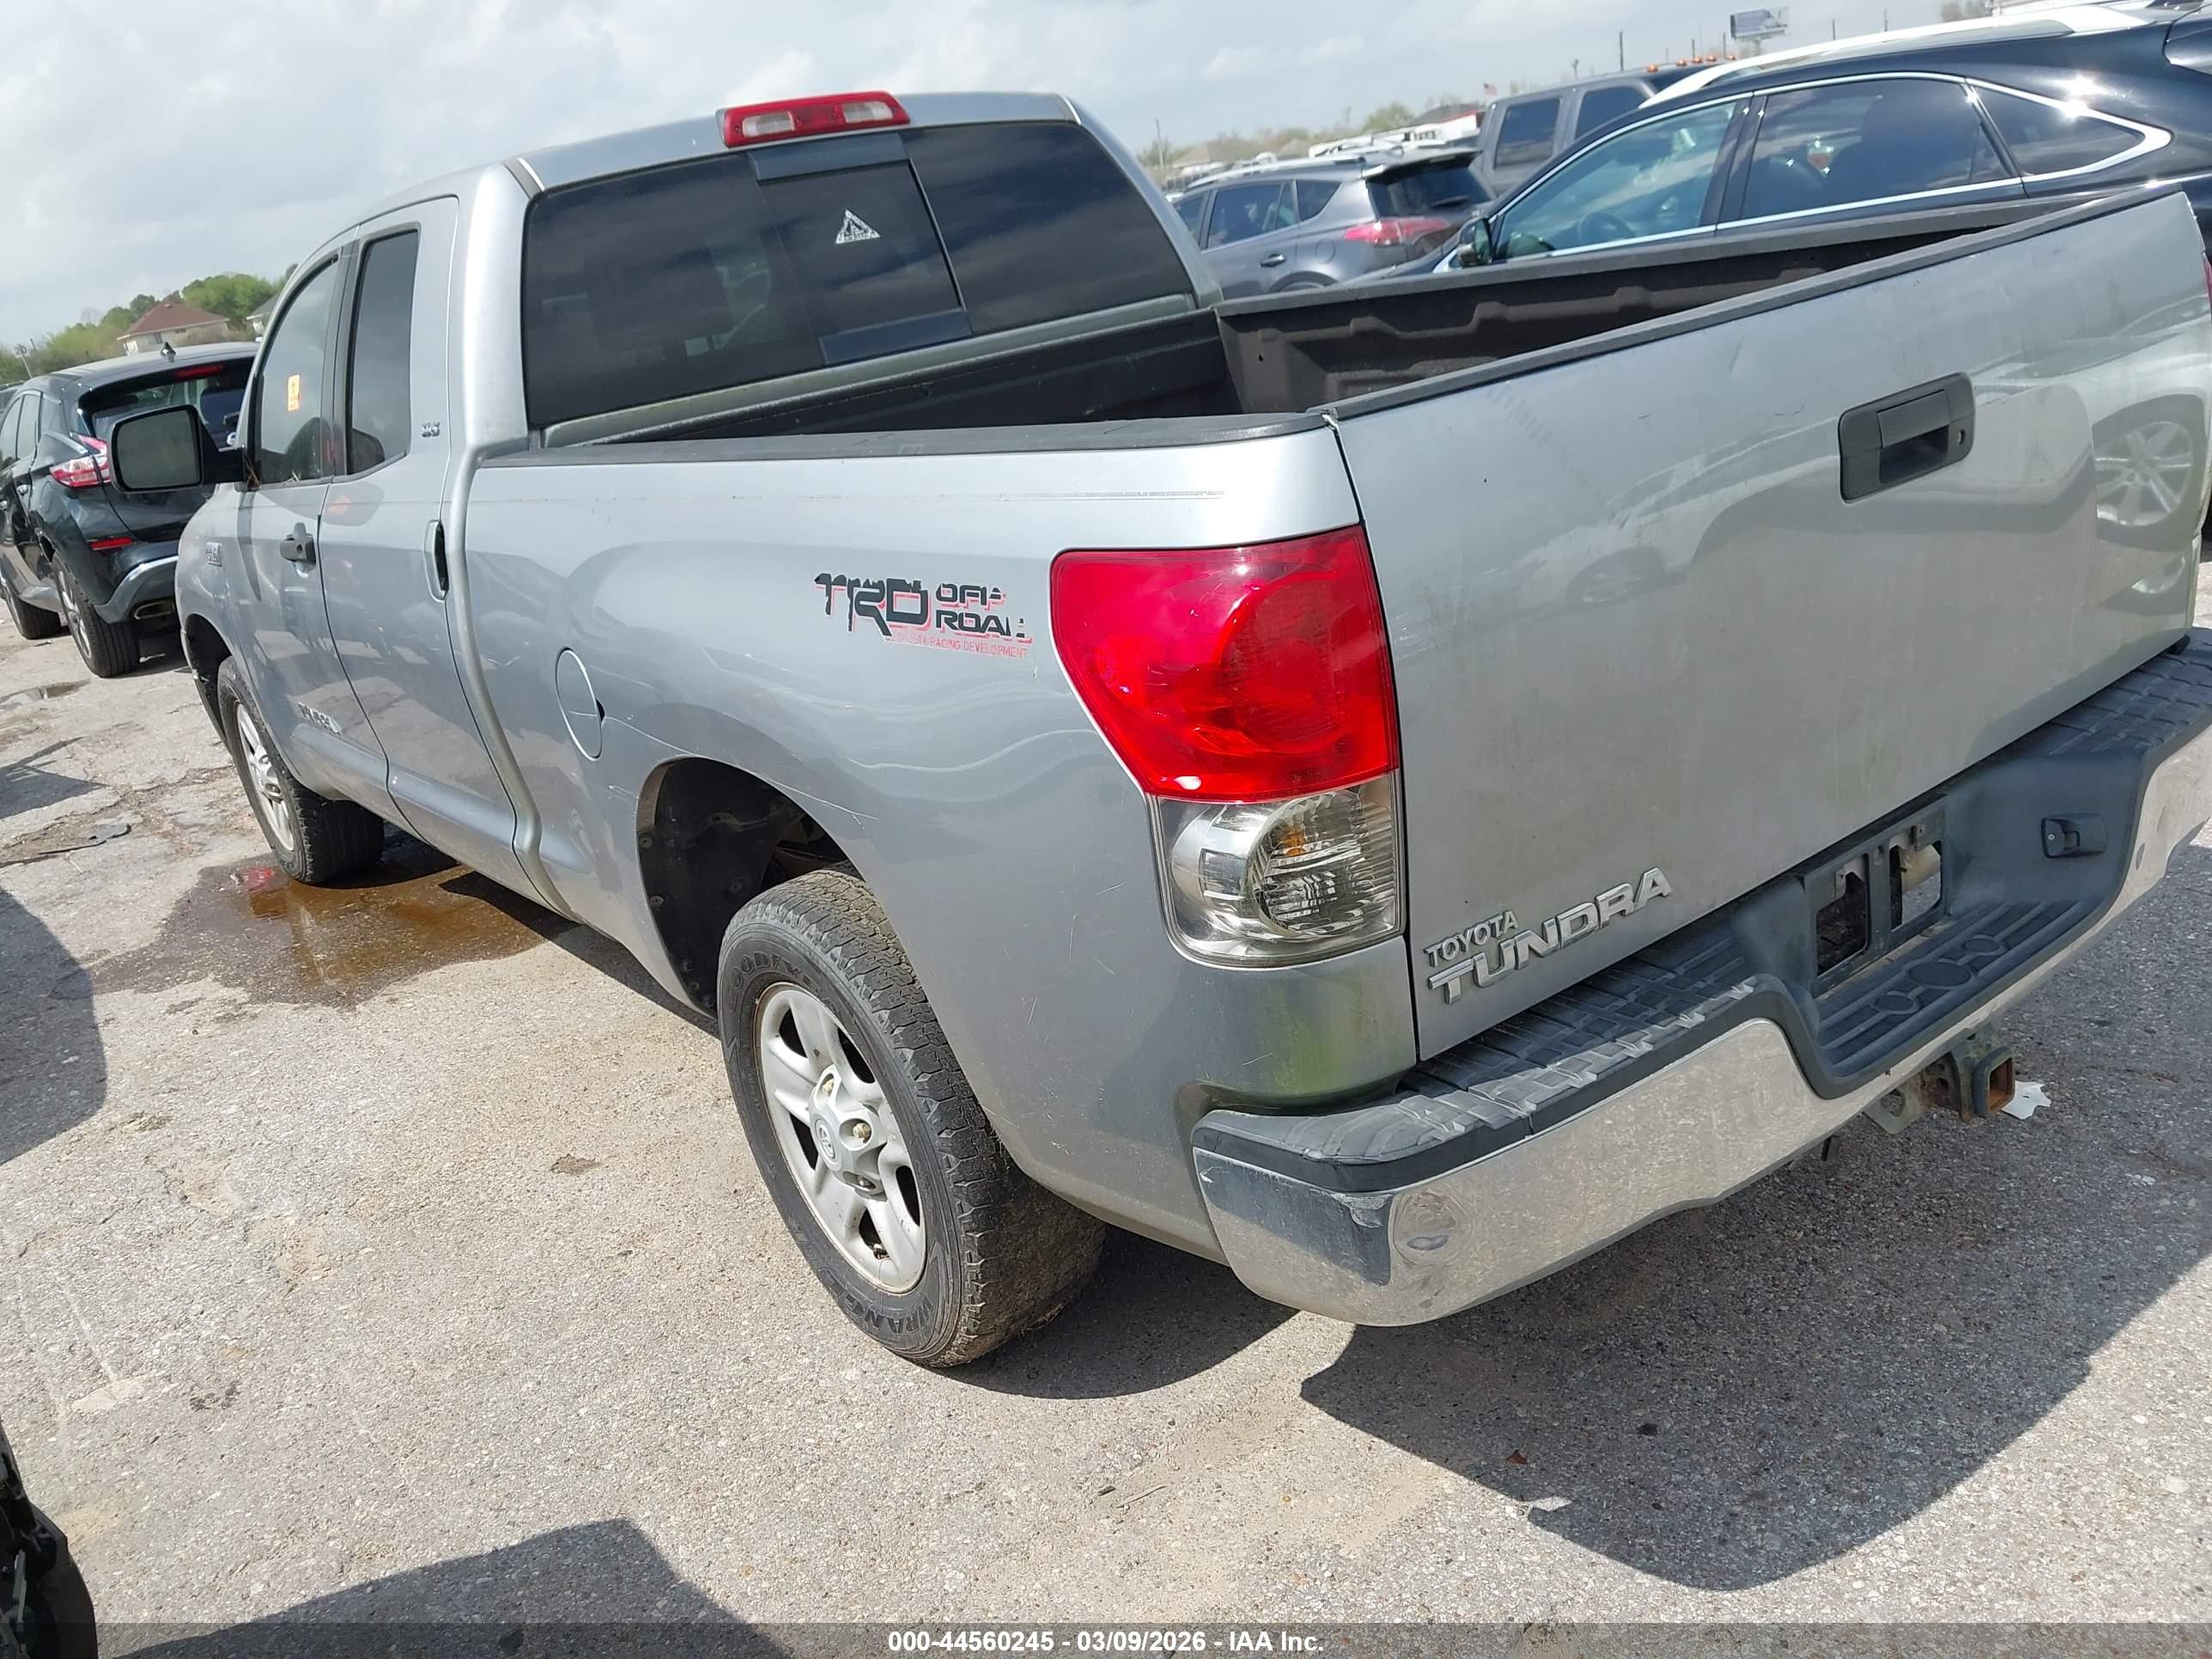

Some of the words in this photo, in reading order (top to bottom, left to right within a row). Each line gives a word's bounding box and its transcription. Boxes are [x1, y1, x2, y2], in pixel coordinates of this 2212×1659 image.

[814, 573, 930, 636] TRD
[930, 637, 961, 650] RACING
[963, 641, 1027, 659] DEVELOPMENT
[1424, 910, 1519, 968] TOYOTA
[1428, 866, 1674, 1004] TUNDRA
